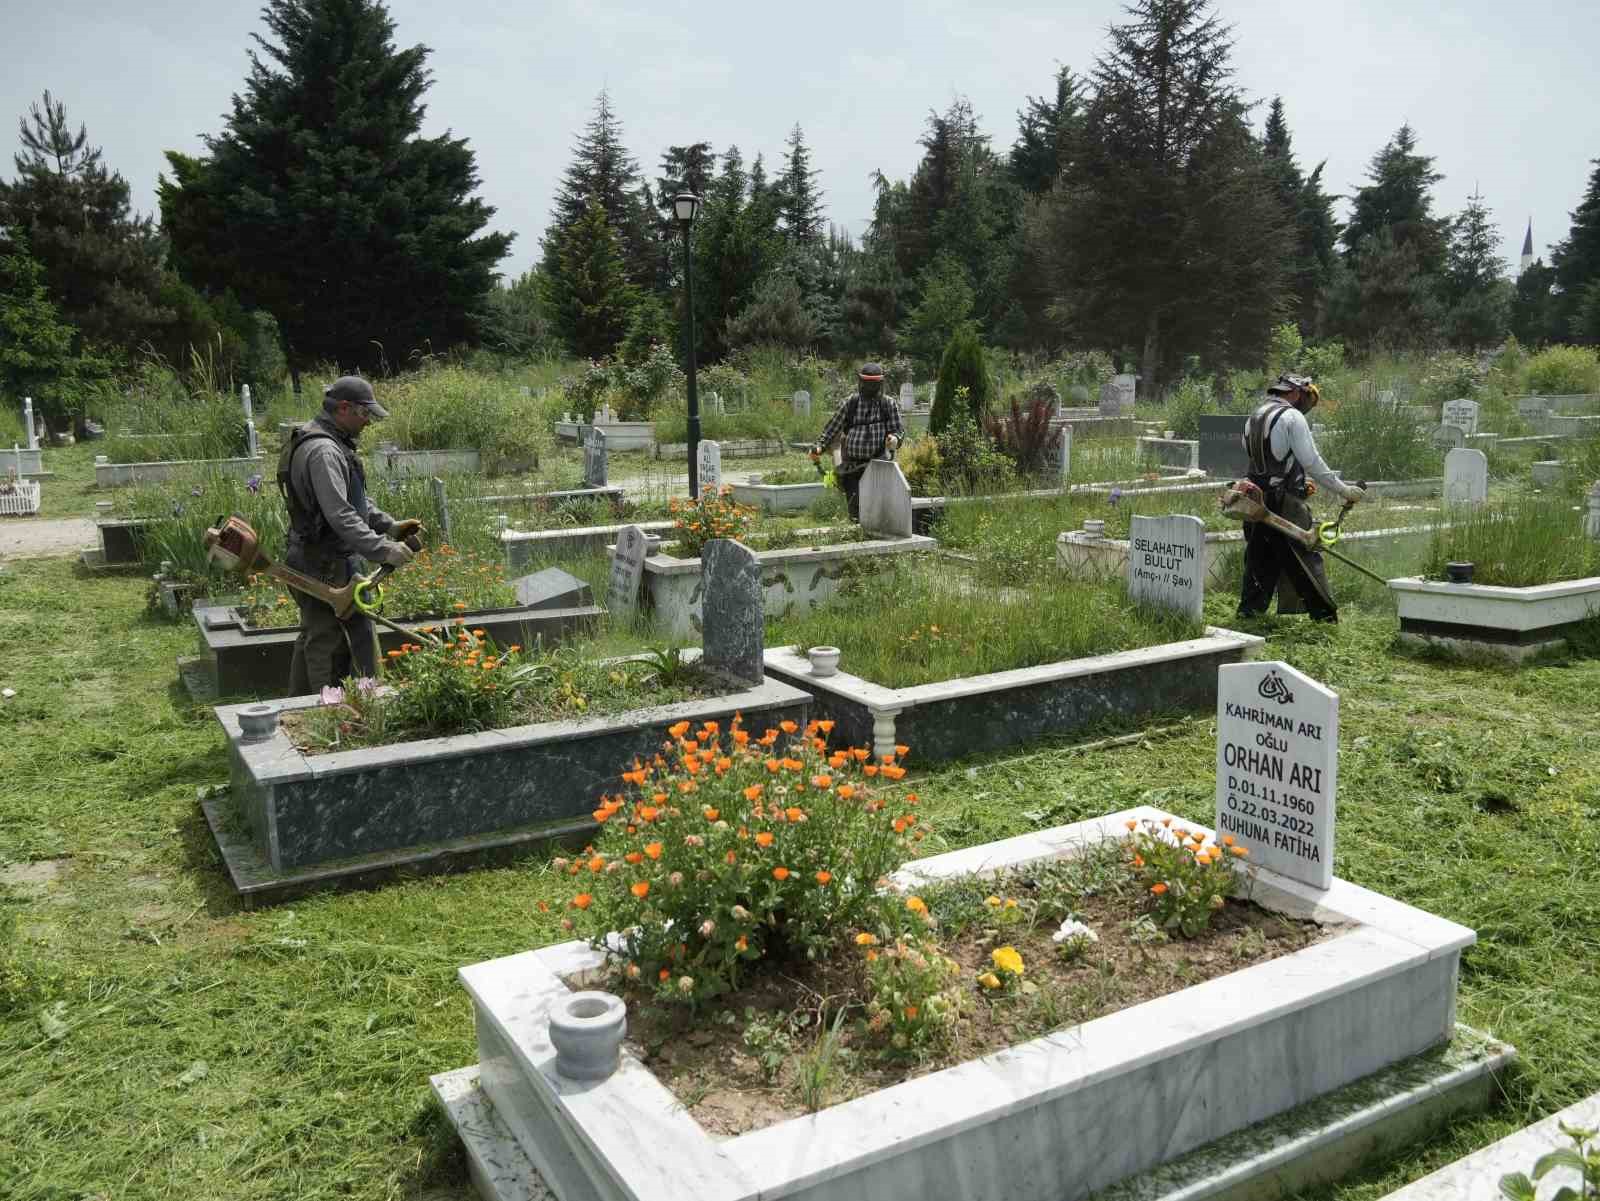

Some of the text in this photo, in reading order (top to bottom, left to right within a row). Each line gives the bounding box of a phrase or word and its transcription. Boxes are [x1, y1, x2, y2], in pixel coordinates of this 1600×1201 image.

[1144, 554, 1182, 571] BULUT
[1226, 702, 1321, 740] KAHRİMAN ARI
[1256, 732, 1288, 753] OĞLU
[1224, 742, 1321, 794] ORHAN ARI
[1227, 793, 1314, 837] Ö.22.03.2022
[1228, 776, 1315, 815] D.01.11.1960
[1221, 812, 1320, 863] RUHUNA FATİHA
